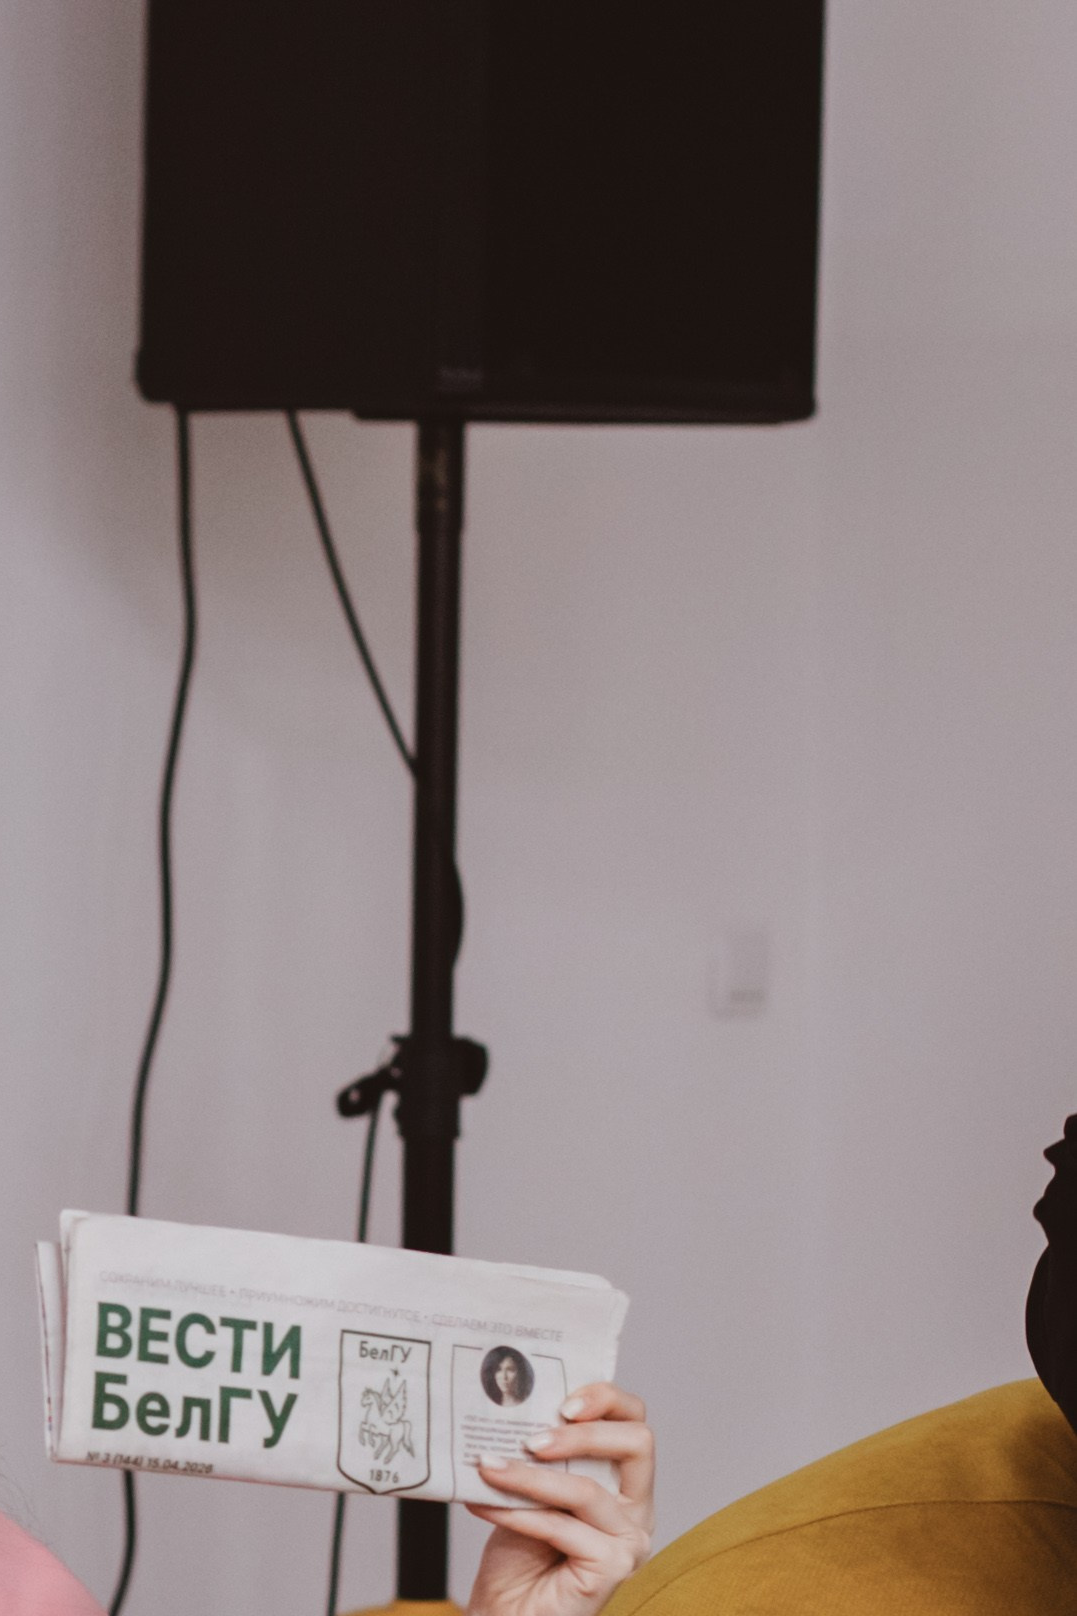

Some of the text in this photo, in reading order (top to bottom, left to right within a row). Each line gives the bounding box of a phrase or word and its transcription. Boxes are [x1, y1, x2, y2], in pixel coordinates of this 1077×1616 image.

[96, 1302, 301, 1379] ВЕСТИ
[337, 1299, 421, 1323] ДОСТИГНУТОЕ
[431, 1312, 488, 1331] СДЕЛАЕМ
[491, 1321, 512, 1336] ЭТО
[514, 1324, 563, 1342] ВМЕСТЕ
[359, 1340, 412, 1363] БелГУ
[92, 1371, 298, 1448] БелГУ
[369, 1469, 399, 1484] 1876
